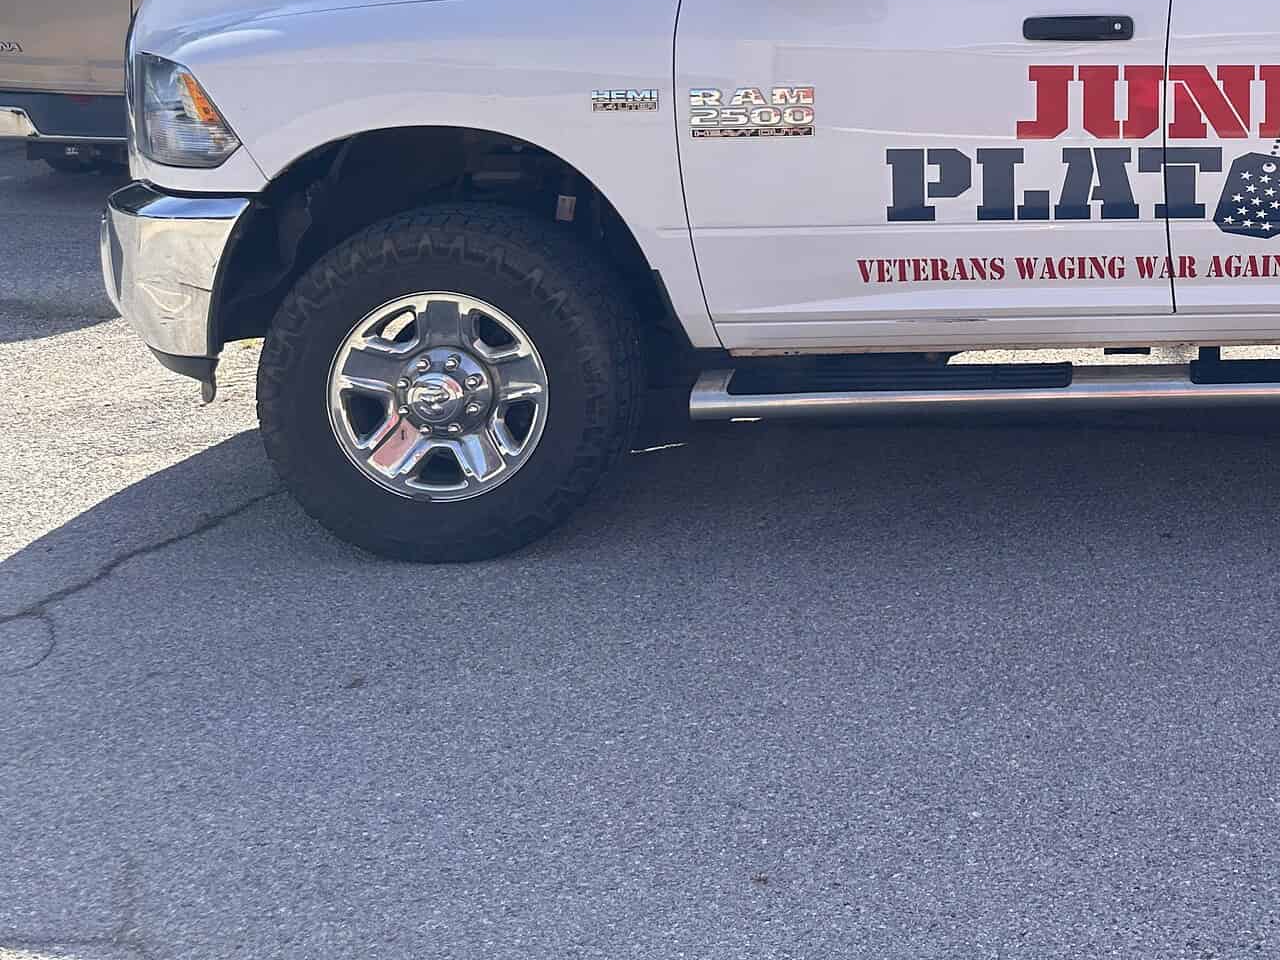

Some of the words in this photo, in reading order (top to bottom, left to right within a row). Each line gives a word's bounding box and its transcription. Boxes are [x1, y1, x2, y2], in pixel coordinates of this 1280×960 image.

[592, 89, 658, 101] HEMI
[689, 87, 815, 106] RAM
[689, 106, 815, 126] 2500
[856, 257, 1005, 283] VETERANS
[1014, 256, 1126, 280] WAGING
[1135, 255, 1198, 279] WAR
